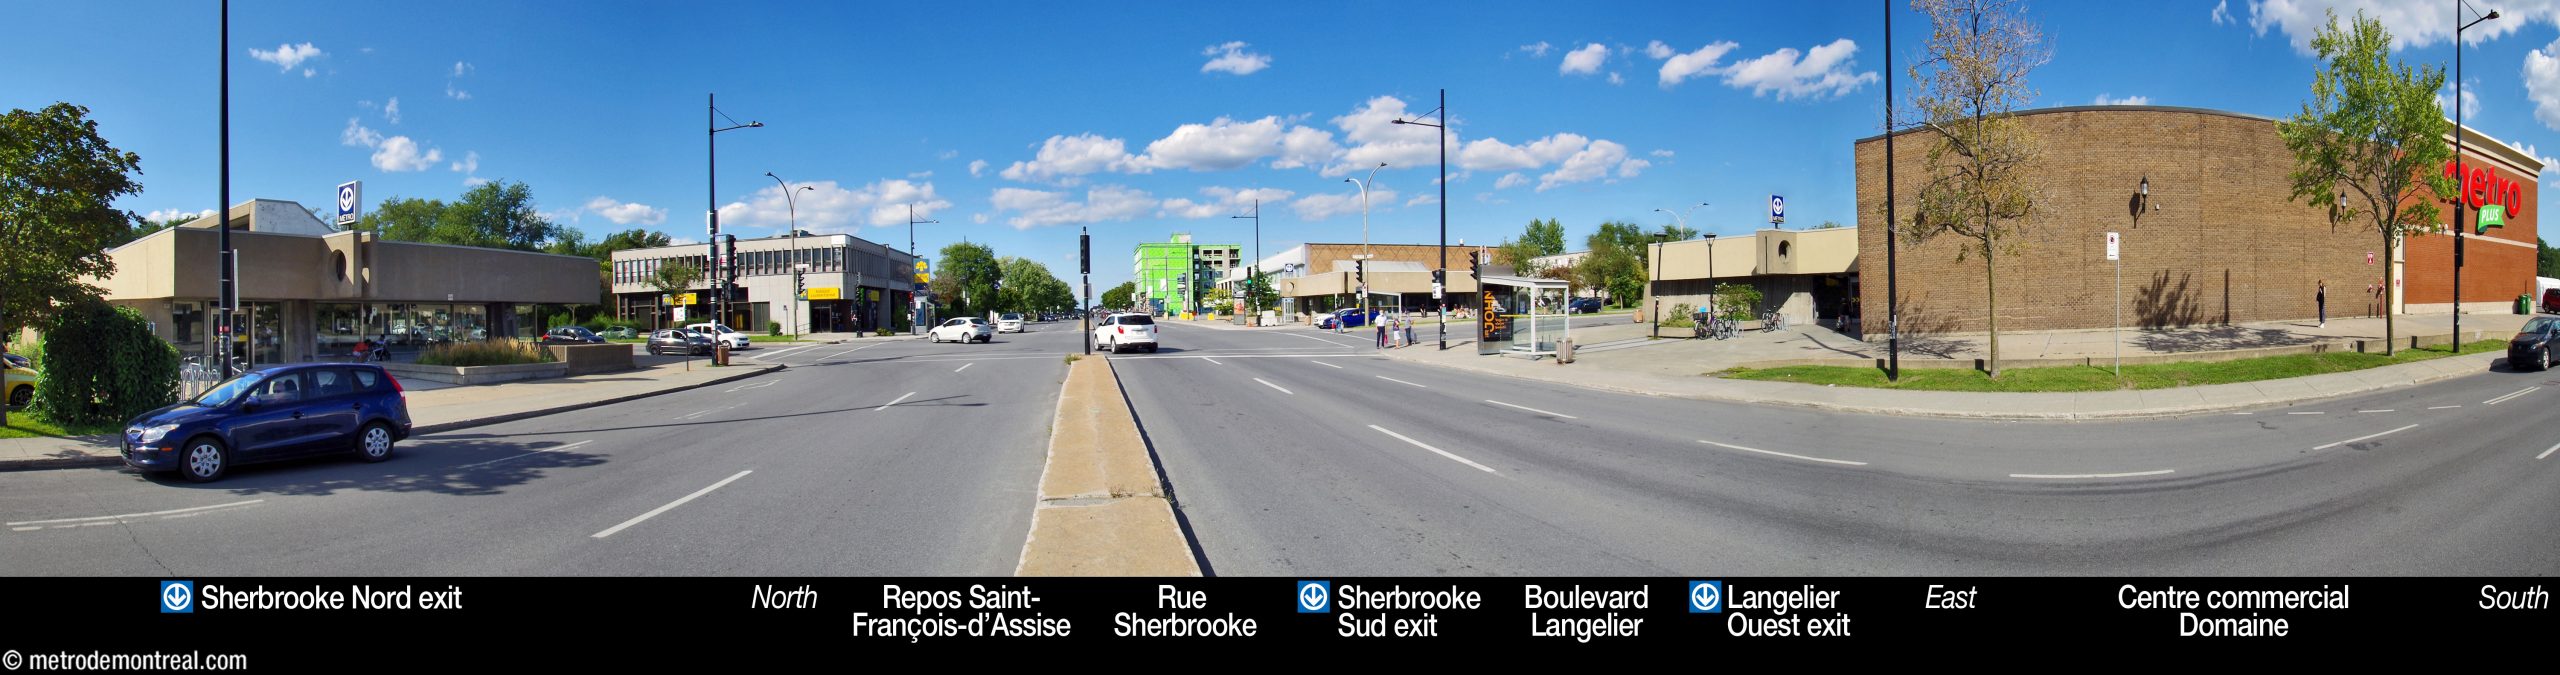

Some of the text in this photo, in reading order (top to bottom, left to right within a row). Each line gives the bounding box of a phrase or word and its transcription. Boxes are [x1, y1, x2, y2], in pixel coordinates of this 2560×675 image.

[2444, 160, 2522, 217] metro
[339, 213, 354, 222] METRO
[2481, 208, 2500, 223] PLUS
[1484, 290, 1495, 332] JOHN
